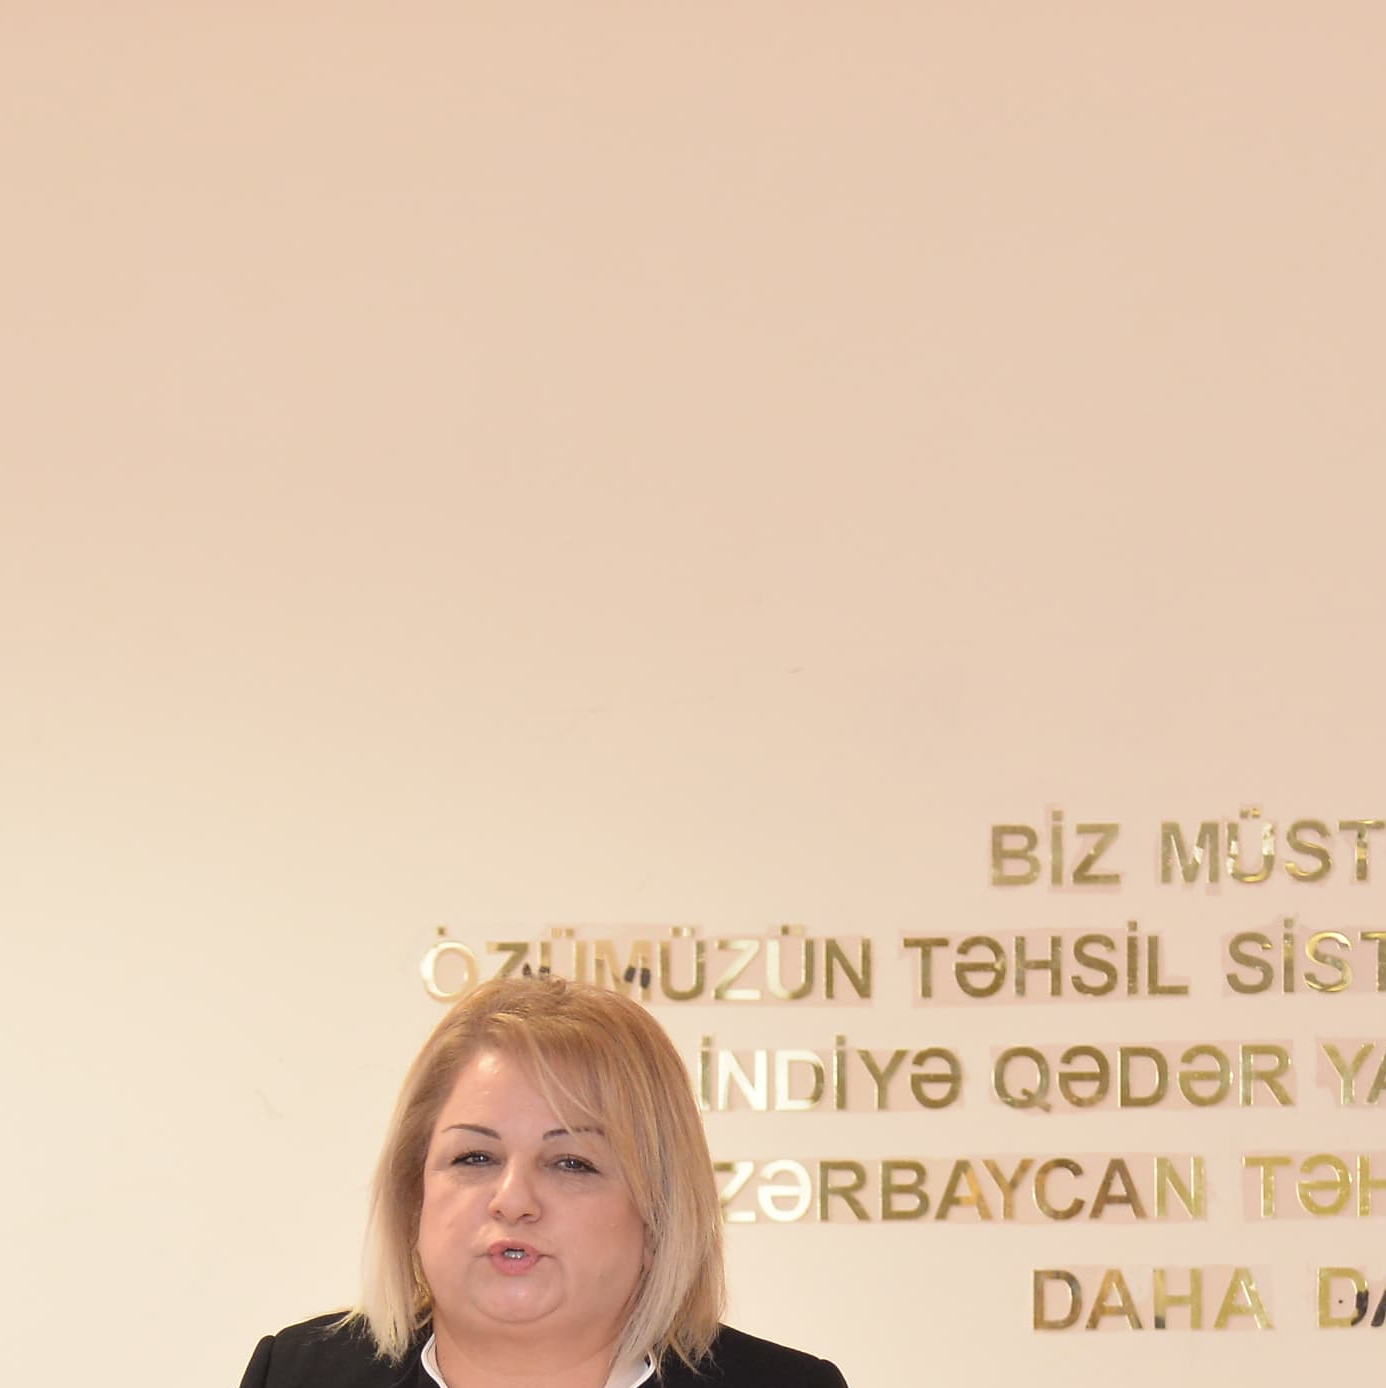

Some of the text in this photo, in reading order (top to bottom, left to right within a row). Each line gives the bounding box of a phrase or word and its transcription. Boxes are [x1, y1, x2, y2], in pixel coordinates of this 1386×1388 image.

[989, 809, 1121, 887] BİZ
[903, 920, 1190, 999] TƏHSİL
[699, 1034, 961, 1112] İNDİYƏ
[993, 1043, 1296, 1113] QƏDƏR
[714, 1157, 1206, 1221] ZƏRBAYCAN
[1032, 1266, 1273, 1332] DAHA
